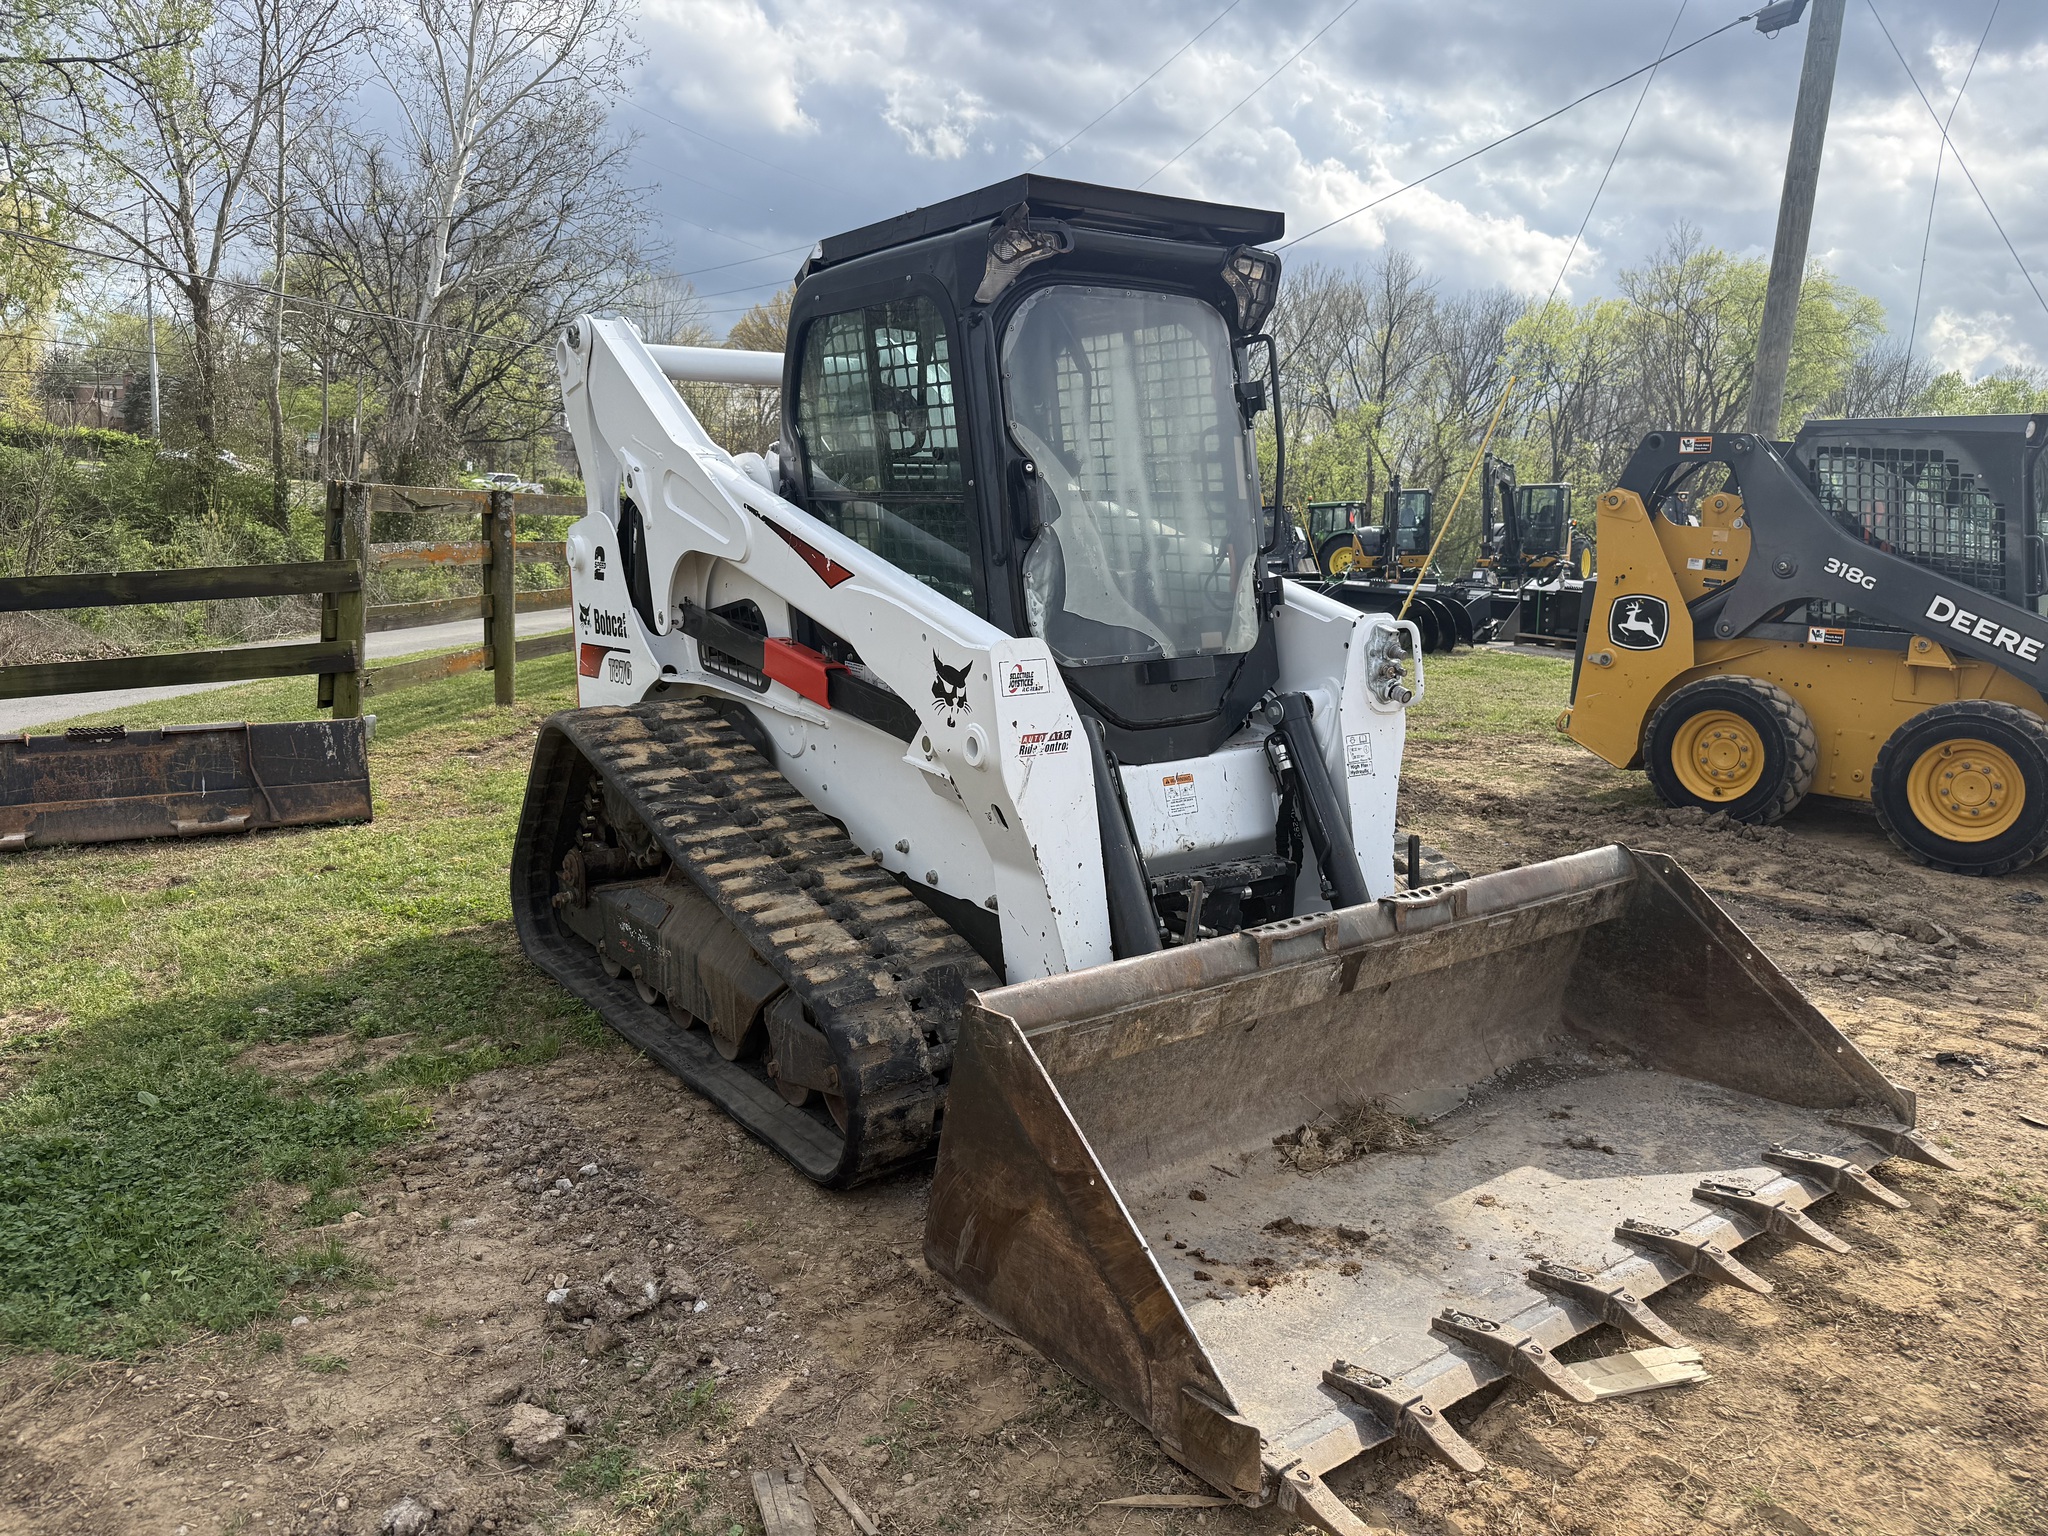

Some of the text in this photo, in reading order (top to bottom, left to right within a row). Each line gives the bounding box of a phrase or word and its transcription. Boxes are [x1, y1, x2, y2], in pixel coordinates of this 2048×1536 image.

[1823, 557, 1877, 590] 318G
[593, 608, 628, 639] Bobcat
[1926, 594, 2046, 663] DEERE
[1008, 679, 1034, 688] JOYSTICKS
[1039, 741, 1069, 753] ontro
